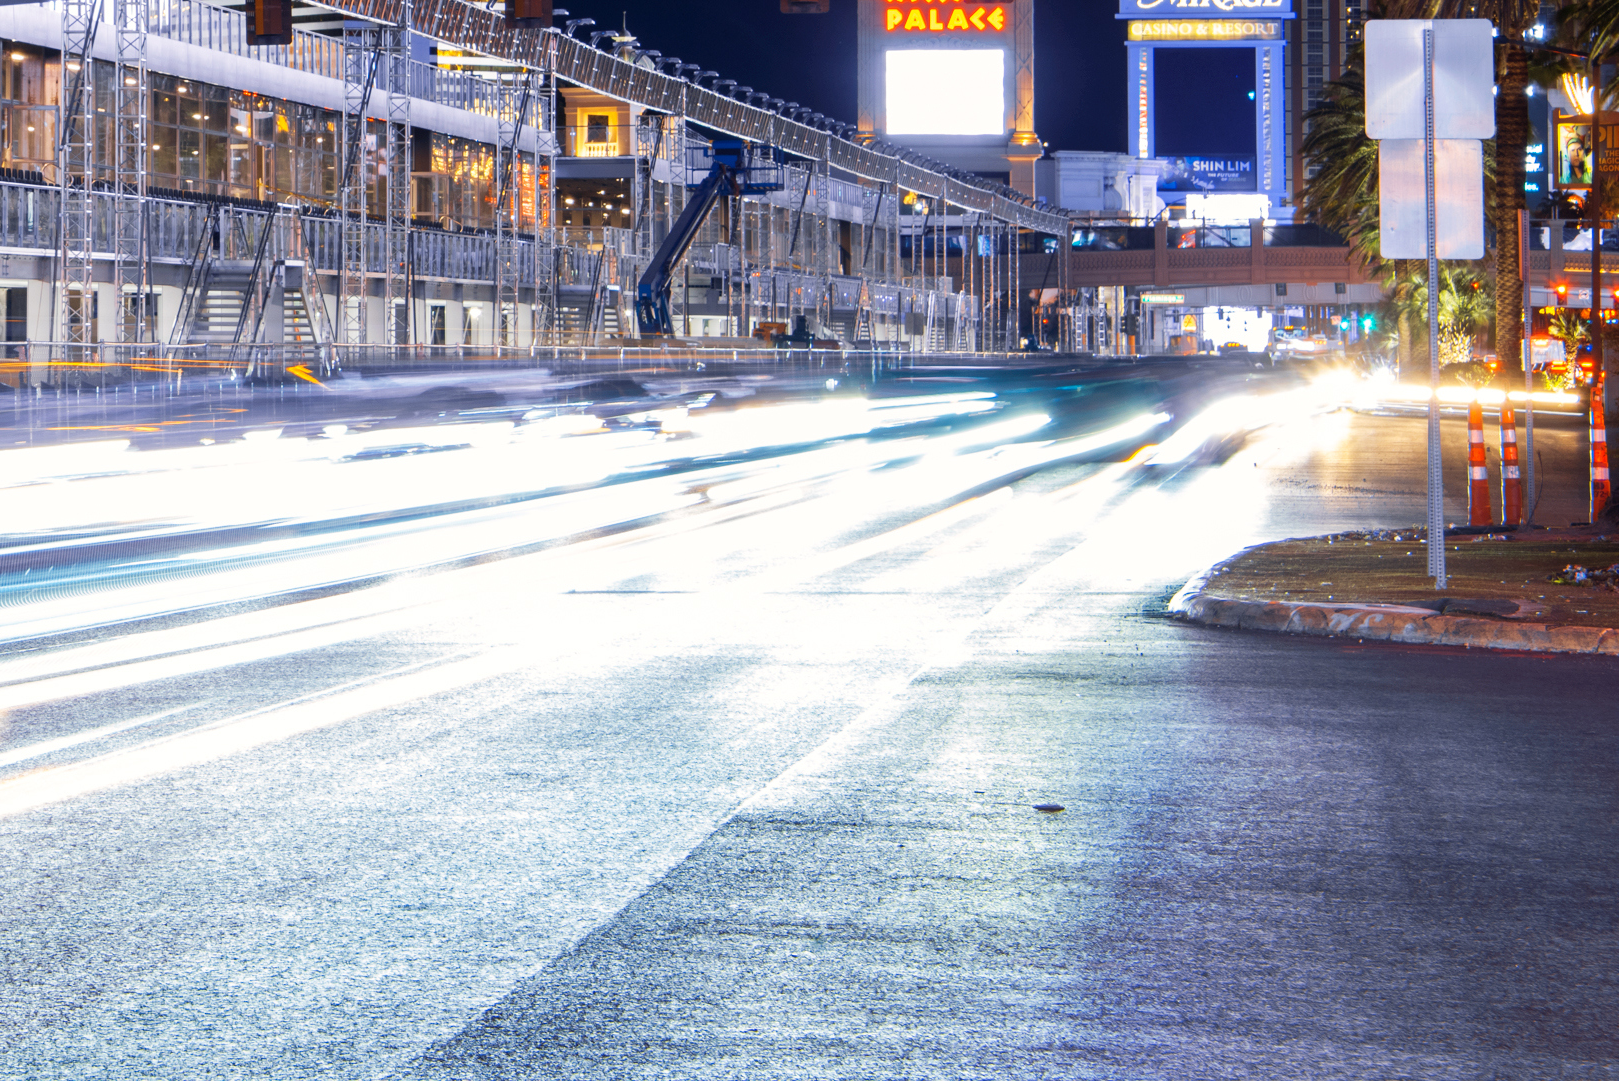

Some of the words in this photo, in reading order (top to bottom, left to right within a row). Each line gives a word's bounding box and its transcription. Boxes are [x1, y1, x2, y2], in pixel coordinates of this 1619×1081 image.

[887, 7, 1004, 30] PALACE
[1131, 23, 1192, 35] CASINO
[1196, 24, 1208, 35] &
[1211, 22, 1278, 35] RESORT
[1193, 160, 1225, 171] SHIN
[1227, 160, 1250, 171] LIM
